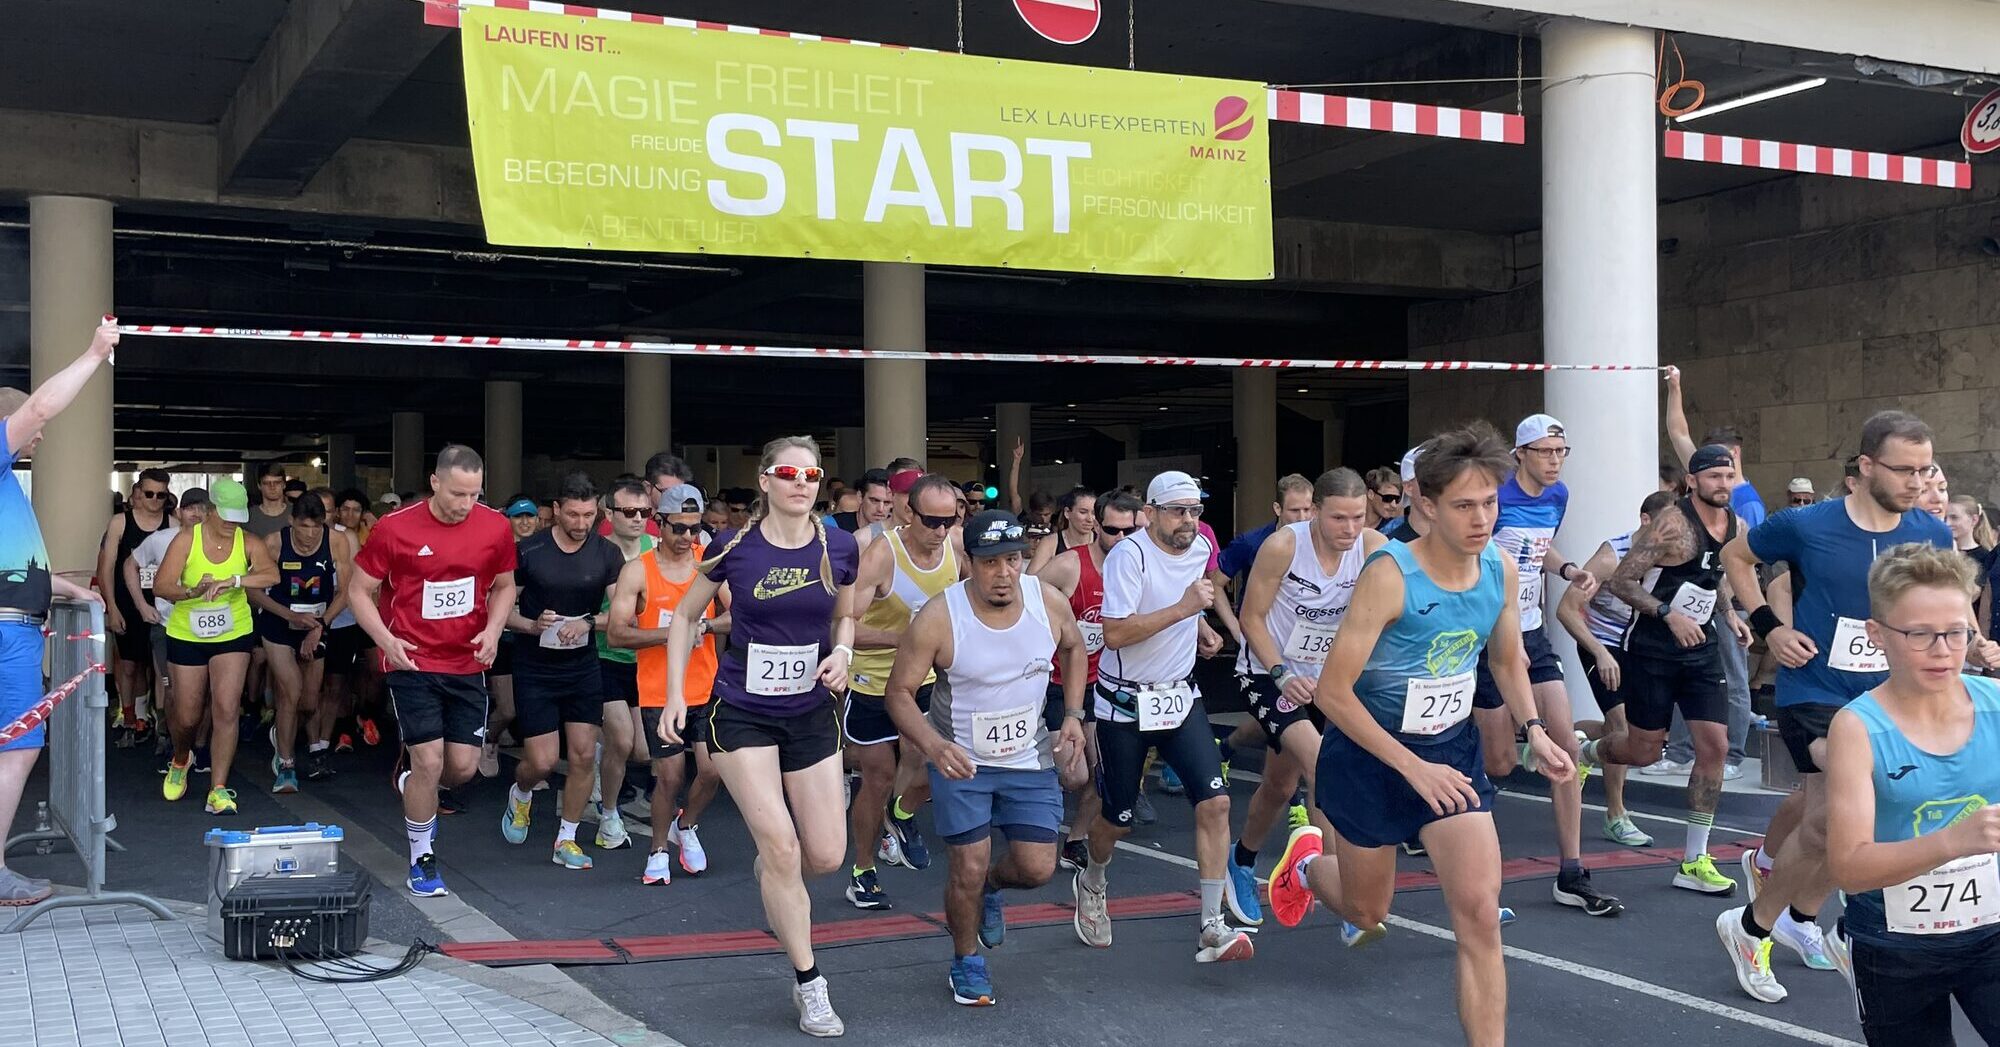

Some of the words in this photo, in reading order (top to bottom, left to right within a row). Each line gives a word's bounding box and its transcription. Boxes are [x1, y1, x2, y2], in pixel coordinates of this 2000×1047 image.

[483, 24, 569, 50] LAUFEN
[575, 33, 621, 55] IST...
[501, 64, 700, 125] MAGIE
[714, 60, 933, 117] FREIHEIT
[1000, 106, 1038, 124] LEX
[1046, 110, 1207, 137] LAUFEXPERTEN
[630, 133, 703, 154] FREUDE
[1189, 145, 1248, 163] MAINZ
[503, 158, 701, 192] BEGEGNUNG
[705, 112, 1092, 234] START
[1073, 165, 1207, 195] LEICHTIGKEIT
[1083, 194, 1257, 225] PERSÖNLICHKEIT
[579, 213, 758, 244] ABENTEUER
[1057, 226, 1176, 265] GLÜCK
[433, 590, 467, 608] 582
[1682, 595, 1712, 615] 256
[197, 613, 227, 629] 688
[1298, 634, 1334, 653] 138
[1849, 636, 1886, 656] 69
[760, 660, 807, 681] 219
[1150, 694, 1184, 716] 320
[1420, 690, 1464, 719] 275
[986, 719, 1028, 744] 418
[1907, 878, 1982, 913] 274
